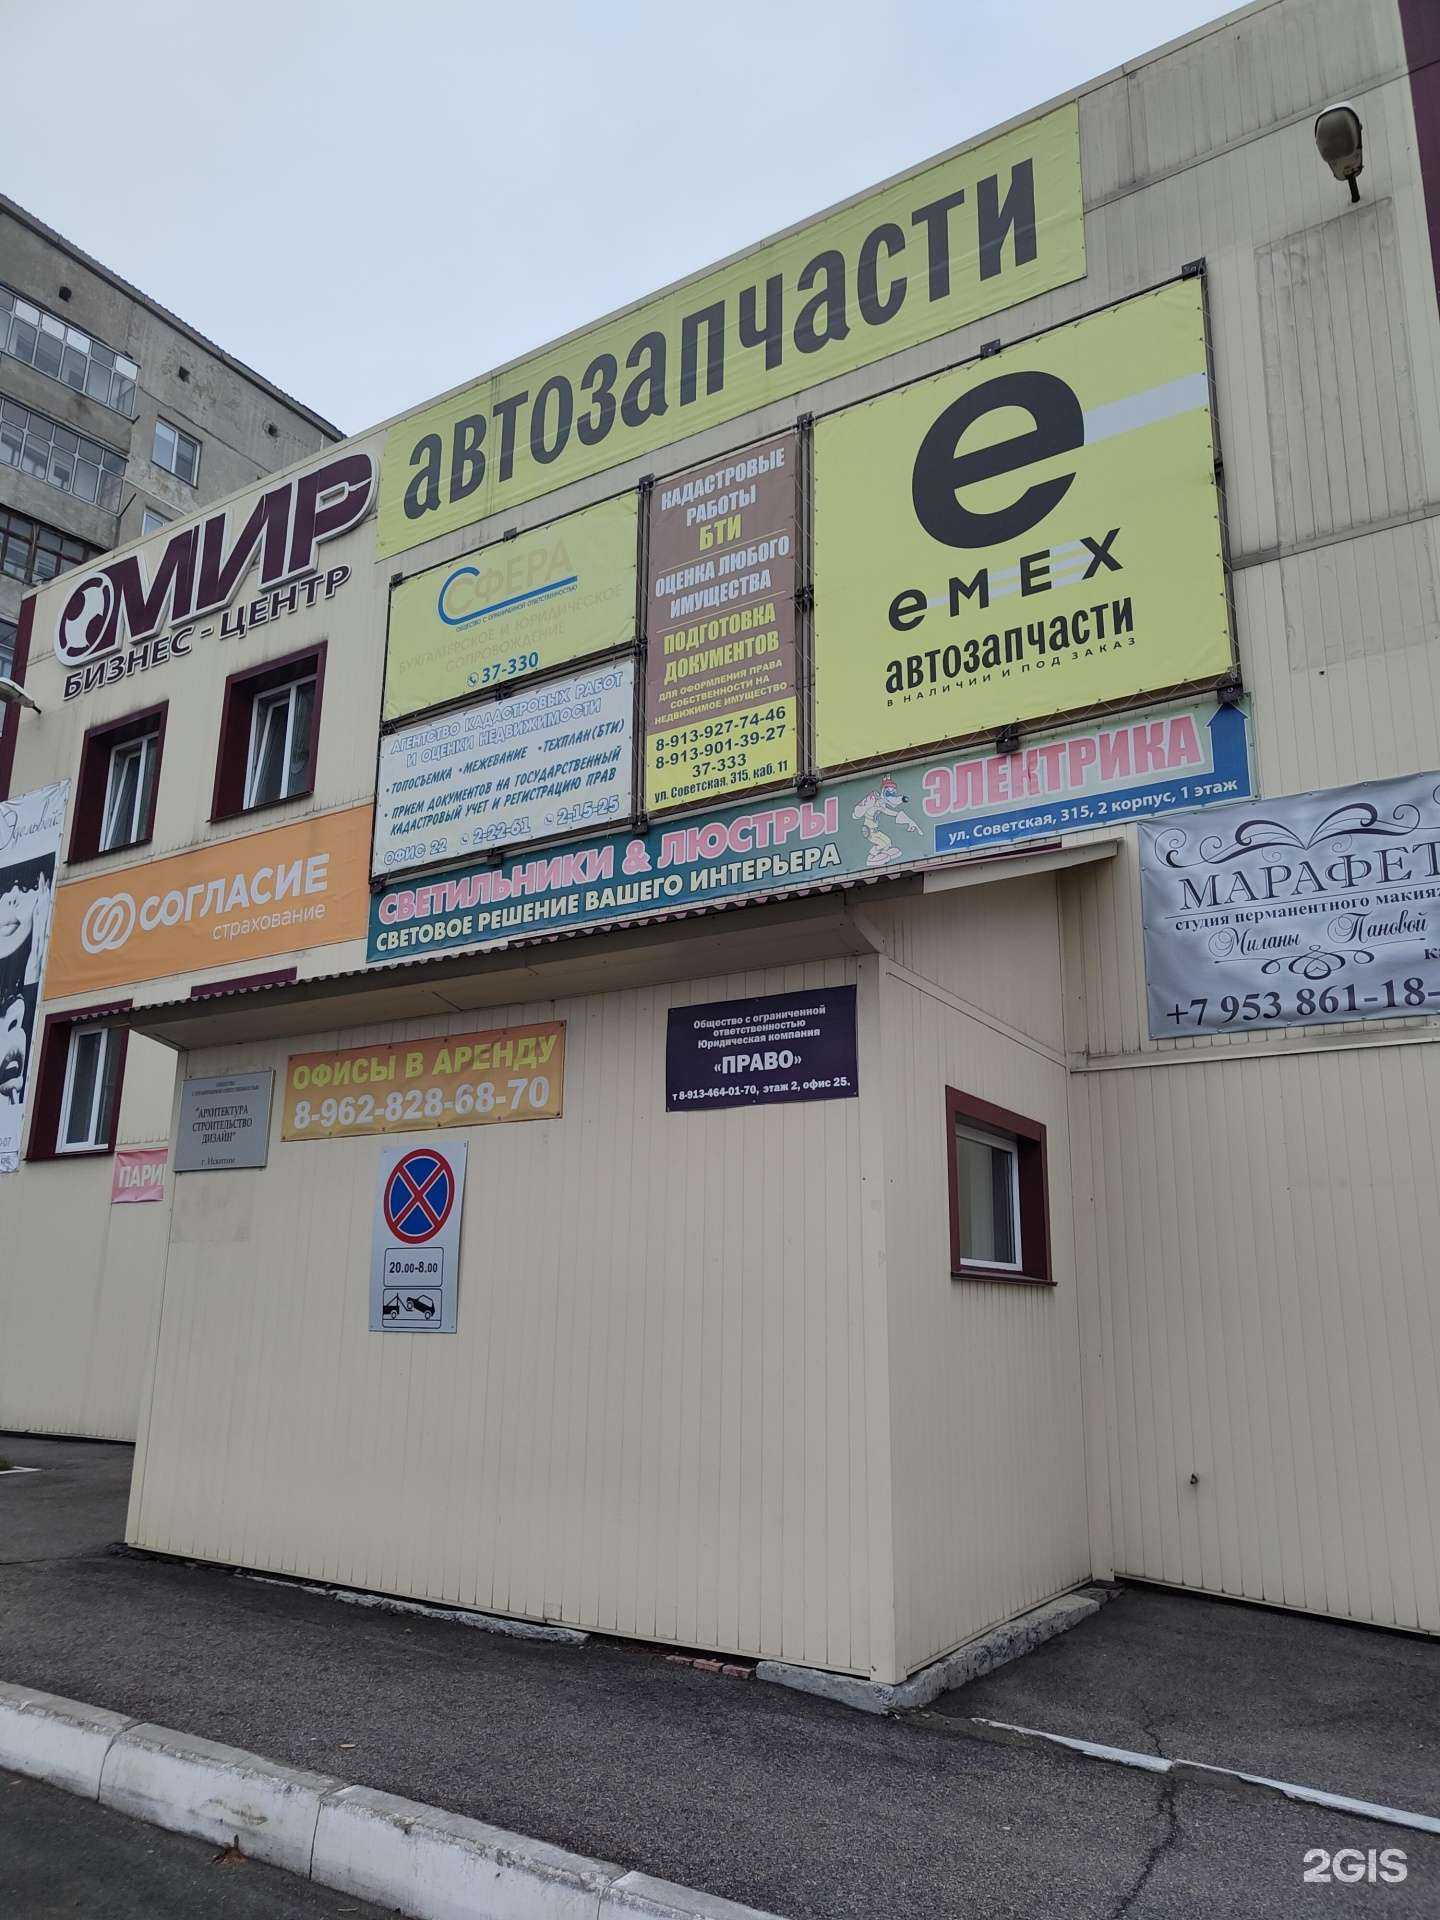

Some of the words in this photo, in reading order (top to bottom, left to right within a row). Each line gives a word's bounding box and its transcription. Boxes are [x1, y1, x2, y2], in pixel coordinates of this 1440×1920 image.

[403, 158, 1038, 519] автозапчасти
[661, 448, 785, 511] КАДАСТРОВЫЕ
[686, 485, 756, 527] РАБОТЫ
[700, 514, 742, 550] БТИ
[656, 561, 715, 597] ОЦЕНКА
[719, 535, 790, 576] ЛЮБОГО
[670, 569, 771, 619] ИМУЩЕСТВА
[664, 602, 775, 655] ПОДГОТОВКА
[885, 597, 1134, 693] автозапчасти
[481, 653, 539, 683] 37-330
[659, 690, 678, 702] ДЛЯ
[681, 669, 746, 694] ОФОРМЛЕНИЯ
[750, 659, 783, 673] ПРАВА
[664, 630, 779, 685] ДОКУМЕНТОВ
[904, 674, 991, 703] НАЛИЧИИ
[1002, 669, 1010, 678] И
[1021, 656, 1061, 673] ПОД
[1072, 637, 1136, 660] ЗАКАЗ
[391, 722, 460, 754] АГЕНТСТВО
[464, 690, 571, 731] КАДАСТРОВЫХ
[575, 671, 623, 699] РАБОТ
[655, 700, 721, 725] НЕДВИЖИМОЕ
[724, 682, 787, 705] ИМУЩЕСТВО
[670, 680, 753, 708] СОБСТВЕННОСТИ
[756, 675, 769, 685] НА
[406, 752, 417, 768] И
[421, 735, 474, 763] ОЦЕНКИ
[478, 699, 601, 746] НЕДВИЖИМОСТИ
[656, 705, 786, 752] 8-913-927-74-46
[656, 725, 786, 769] 8-913-901-39-27
[391, 800, 425, 819] ПРИЕМ
[427, 782, 492, 811] ДОКУМЕНТОВ
[496, 776, 509, 791] НА
[514, 745, 621, 787] ГОСУДАРСТВЕННЫЙ
[462, 746, 528, 775] МЕЖЕВАНИЕ
[655, 790, 668, 803] ул.
[753, 763, 775, 778] каб.
[777, 760, 788, 772] 11
[692, 753, 747, 778] 37-333
[922, 714, 1206, 817] ЭЛЕКТРИКА
[391, 804, 462, 836] КАДАСТРОВЫЙ
[465, 799, 489, 816] УЧЕТ
[492, 797, 501, 809] И
[504, 776, 581, 808] РЕГИСТРАЦИЮ
[586, 767, 616, 786] ПРАВ
[948, 829, 970, 846] ул.
[973, 814, 1057, 838] Советская,
[1060, 803, 1094, 823] 315,
[1098, 802, 1109, 815] 2
[1111, 790, 1177, 816] корпус,
[1180, 786, 1189, 799] 1
[1192, 781, 1238, 798] этаж
[384, 843, 426, 865] ОФИС
[430, 838, 447, 855] 22
[473, 817, 532, 845] 2-22-61
[557, 794, 619, 825] 2-15-25
[378, 845, 614, 925] СВЕТИЛЬНИКИ
[622, 839, 650, 875] &
[657, 796, 839, 869] ЛЮСТРЫ
[1178, 840, 1440, 911] МАРАФЕТ
[138, 853, 330, 932] СОГЛАСИЕ
[375, 915, 473, 952] СВЕТОВОЕ
[478, 897, 578, 934] РЕШЕНИЕ
[585, 875, 684, 912] ВАШЕГО
[690, 843, 841, 893] ИНТЕРЬЕРА
[1175, 914, 1230, 933] студия
[1235, 895, 1370, 924] перманентного
[212, 902, 326, 942] страхование
[1208, 927, 1301, 957] Миланы
[1327, 909, 1429, 944] Пановой
[693, 1017, 743, 1029] Общество
[753, 1005, 826, 1023] ограниченной
[713, 1019, 806, 1037] ответственностью
[1166, 998, 1208, 1026] +7
[1220, 991, 1282, 1024] 953
[293, 1055, 396, 1090] ОФИСЫ
[405, 1052, 424, 1078] В
[432, 1034, 558, 1076] АРЕНДУ
[698, 1035, 766, 1050] Юридическая
[768, 1029, 821, 1042] компания
[714, 1049, 802, 1074] «ПРАВО»
[294, 1076, 549, 1130] 8-962-828-68-70
[679, 1085, 760, 1100] 8-913-464-01-70,
[763, 1082, 788, 1093] этаж
[791, 1081, 801, 1092] 2,
[802, 1079, 831, 1091] офис
[833, 1076, 851, 1087] 25.
[192, 1118, 253, 1133] СТРОИТЕЛЬСТВО
[118, 1163, 167, 1188] ПАРИ
[389, 1261, 438, 1274] 20.00-8.00
